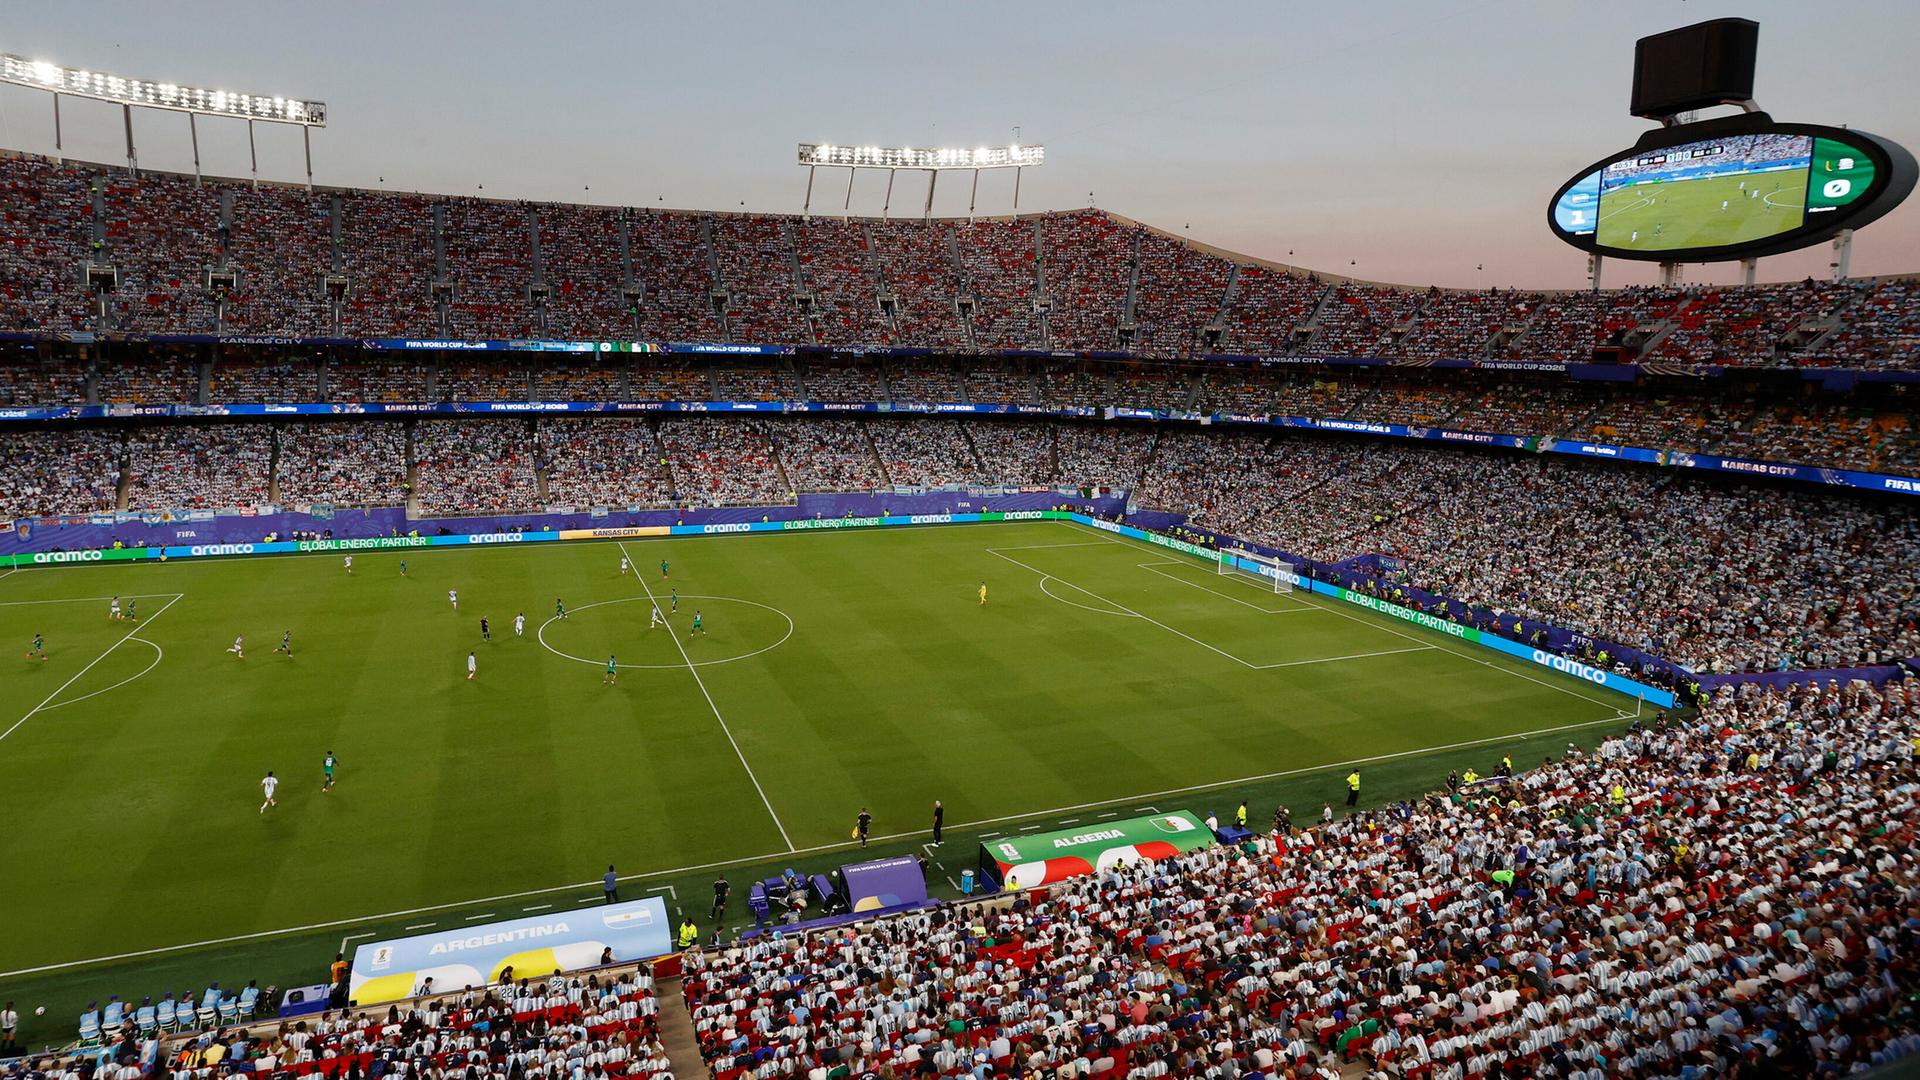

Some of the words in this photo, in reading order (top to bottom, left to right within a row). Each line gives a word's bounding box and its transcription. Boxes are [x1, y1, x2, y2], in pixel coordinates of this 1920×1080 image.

[1823, 179, 1851, 198] 0
[1570, 210, 1586, 225] 1
[1330, 421, 1354, 430] WORLD
[1354, 423, 1367, 431] CUP
[1442, 432, 1473, 440] KANSAS
[1474, 434, 1493, 442] CITY
[1721, 460, 1767, 474] KANSAS
[1769, 466, 1796, 476] CITY
[1885, 478, 1911, 491] FIFA
[911, 514, 951, 523] aramco
[1004, 511, 1042, 521] aramco
[704, 523, 751, 533] aramco
[784, 520, 814, 530] GLOBAL
[814, 519, 844, 529] ENERGY
[845, 517, 879, 527] PARTNER
[1092, 518, 1121, 533] aramco
[300, 540, 338, 552] GLOBAL
[340, 538, 380, 549] ENERGY
[381, 536, 426, 548] PARTNER
[469, 532, 523, 544] aramco
[191, 543, 254, 555] aramco
[1149, 534, 1169, 548] GLOBAL
[1169, 539, 1193, 553] ENERGY
[1194, 544, 1221, 561] PARTNER
[34, 550, 103, 564] aramco
[1259, 563, 1300, 586] aramco
[1345, 590, 1379, 610] GLOBAL
[1379, 599, 1417, 622] ENERGY
[1417, 611, 1464, 637] PARTNER
[1571, 633, 1593, 646] FIFA
[1533, 649, 1606, 684] aramco
[1052, 828, 1126, 849] ALGERIA
[429, 922, 570, 956] ARGENTINA
[761, 980, 769, 990] 10
[501, 988, 512, 998] 22
[464, 1012, 473, 1022] 10
[887, 1021, 895, 1032] 10
